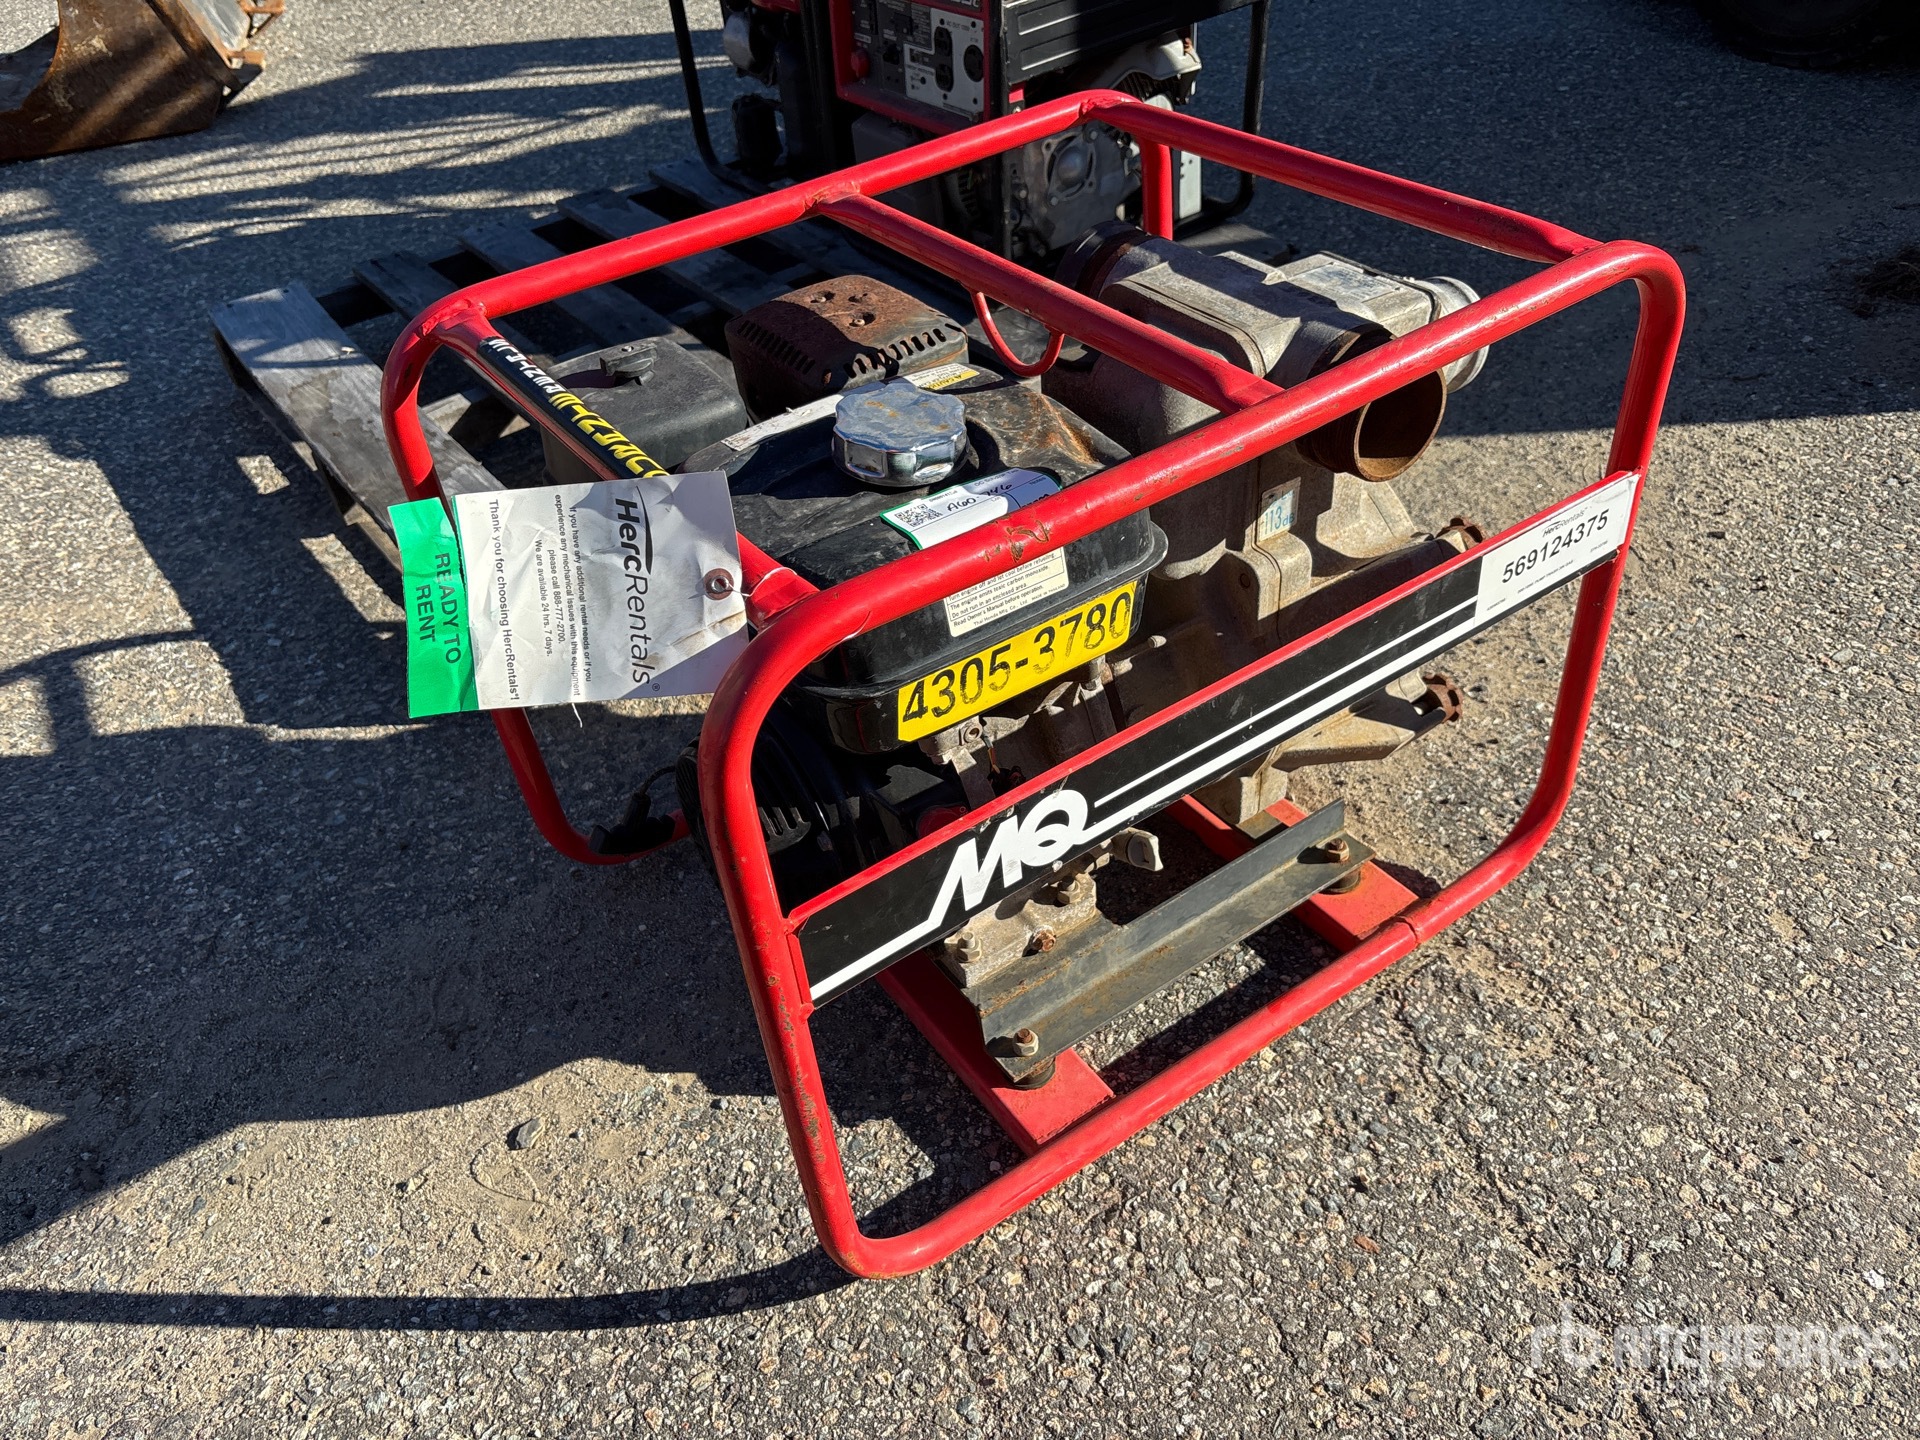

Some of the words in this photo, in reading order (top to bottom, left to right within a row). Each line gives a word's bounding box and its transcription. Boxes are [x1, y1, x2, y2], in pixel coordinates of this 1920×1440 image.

[489, 499, 501, 533] Thank
[555, 494, 566, 536] experience
[568, 513, 577, 528] you
[492, 536, 501, 555] you
[535, 540, 542, 552] We
[1502, 509, 1609, 583] 569124375
[495, 558, 504, 573] for
[547, 550, 557, 574] please
[562, 553, 574, 596] mechanical
[435, 553, 459, 627] READY
[537, 568, 548, 601] available
[552, 576, 560, 589] call
[576, 565, 587, 602] additional
[961, 586, 978, 597] engine
[987, 577, 996, 585] and
[1005, 569, 1016, 577] cool
[1017, 562, 1032, 572] before
[961, 595, 978, 606] engine
[979, 589, 993, 598] emits
[993, 584, 1006, 592] toxic
[1007, 576, 1024, 587] carbon
[993, 587, 1015, 601] enclosed
[416, 584, 435, 642] RENT
[497, 576, 510, 626] choosing
[541, 603, 549, 612] 24
[567, 597, 575, 621] issues
[580, 604, 588, 625] rental
[953, 619, 966, 627] Read
[967, 610, 986, 621] Owner's
[987, 601, 1005, 612] Manual
[1005, 595, 1020, 605] before
[542, 614, 550, 628] hrs.
[553, 590, 566, 643] 888-777-2700.
[569, 623, 577, 639] with
[444, 633, 461, 664] TO
[545, 636, 553, 657] days.
[582, 627, 590, 650] needs
[584, 651, 590, 660] or
[902, 591, 1131, 722] 4305-3780
[571, 656, 580, 696] equipment
[929, 790, 1088, 929] MQ
